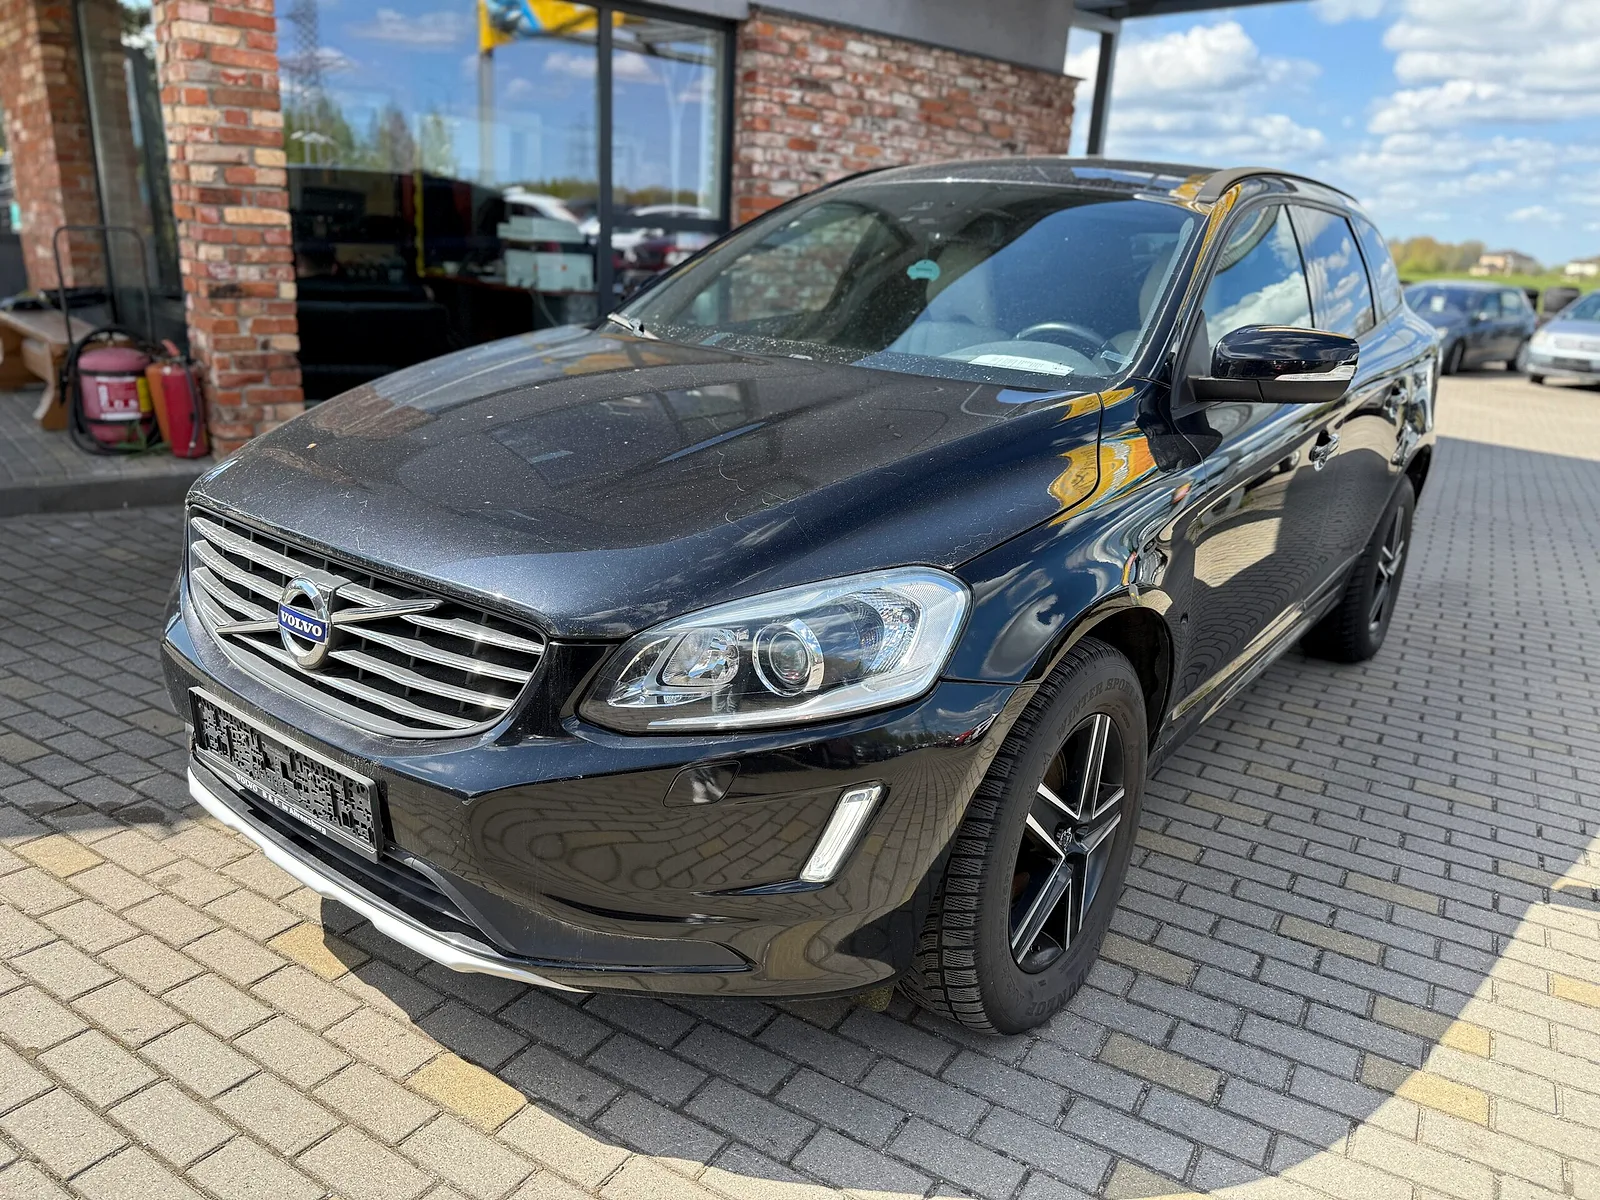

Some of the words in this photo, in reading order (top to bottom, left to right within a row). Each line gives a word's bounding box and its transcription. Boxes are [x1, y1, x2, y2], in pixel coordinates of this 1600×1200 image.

[280, 609, 323, 637] VOLVO
[1104, 677, 1135, 697] SPORT
[235, 772, 258, 792] VOLVO
